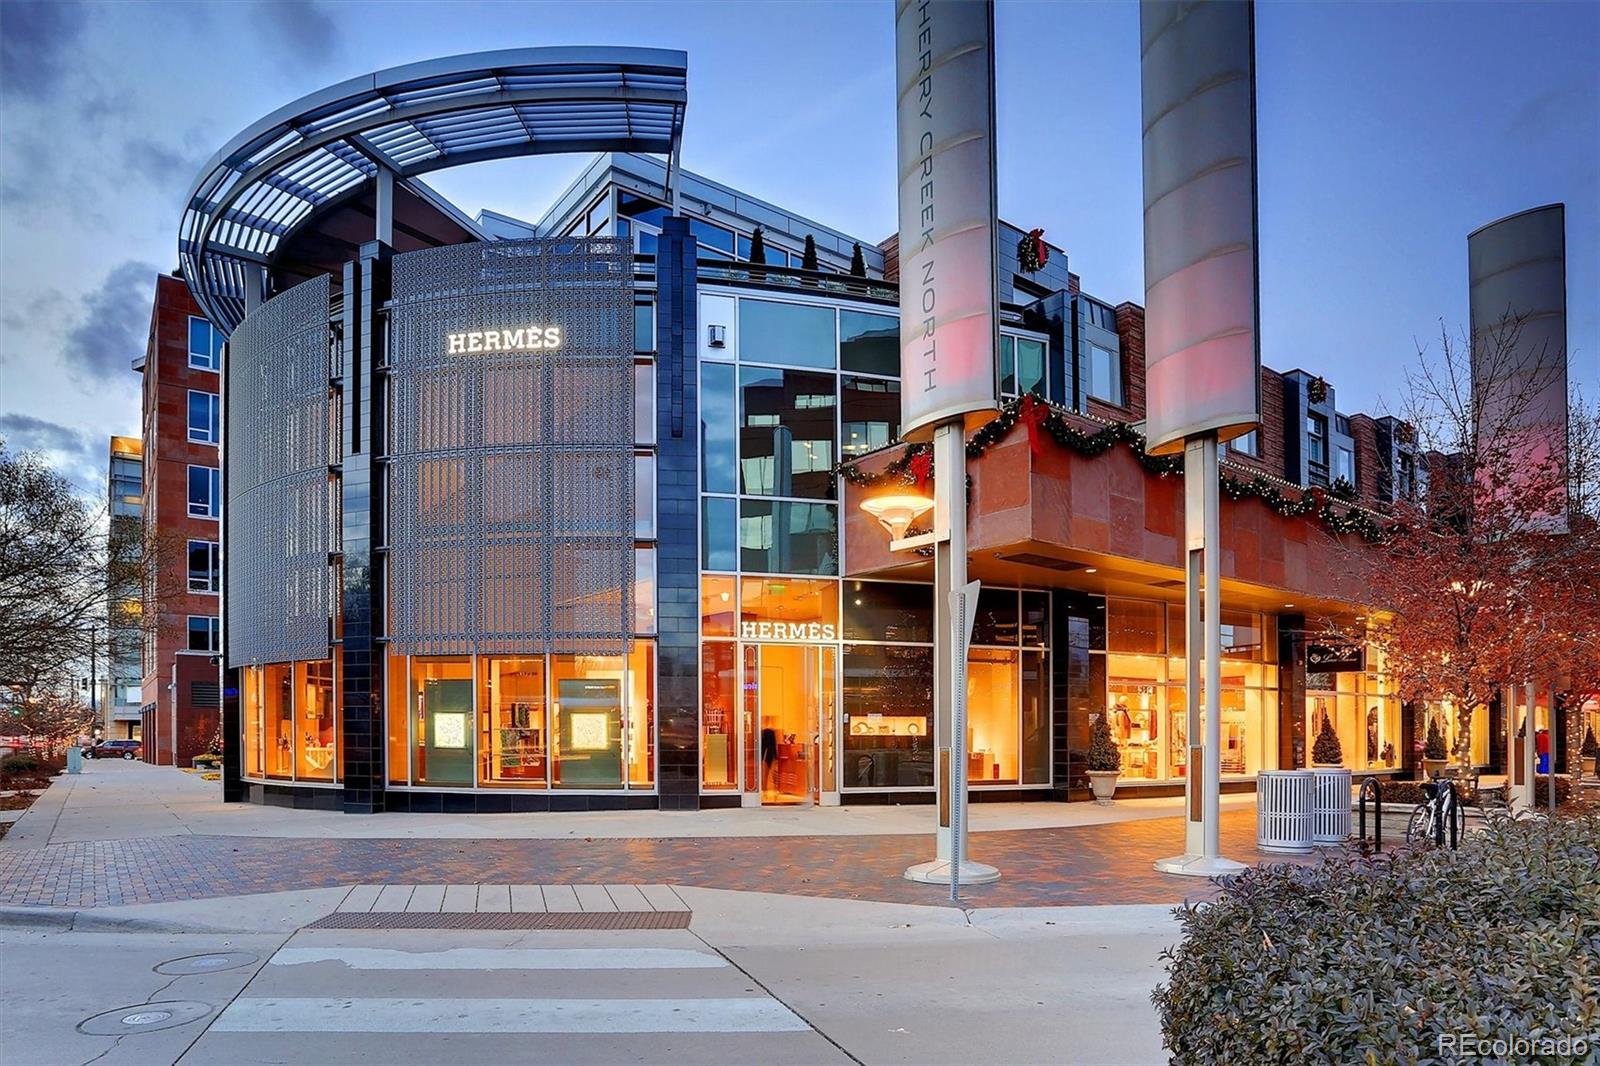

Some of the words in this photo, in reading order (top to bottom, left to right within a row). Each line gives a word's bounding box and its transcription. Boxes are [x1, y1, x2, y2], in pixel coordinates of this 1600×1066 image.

[918, 0, 932, 119] HERRY
[920, 131, 934, 252] CREEK
[448, 326, 561, 354] HERMÈS
[921, 260, 936, 393] NORTH
[741, 622, 836, 640] HERMÈS
